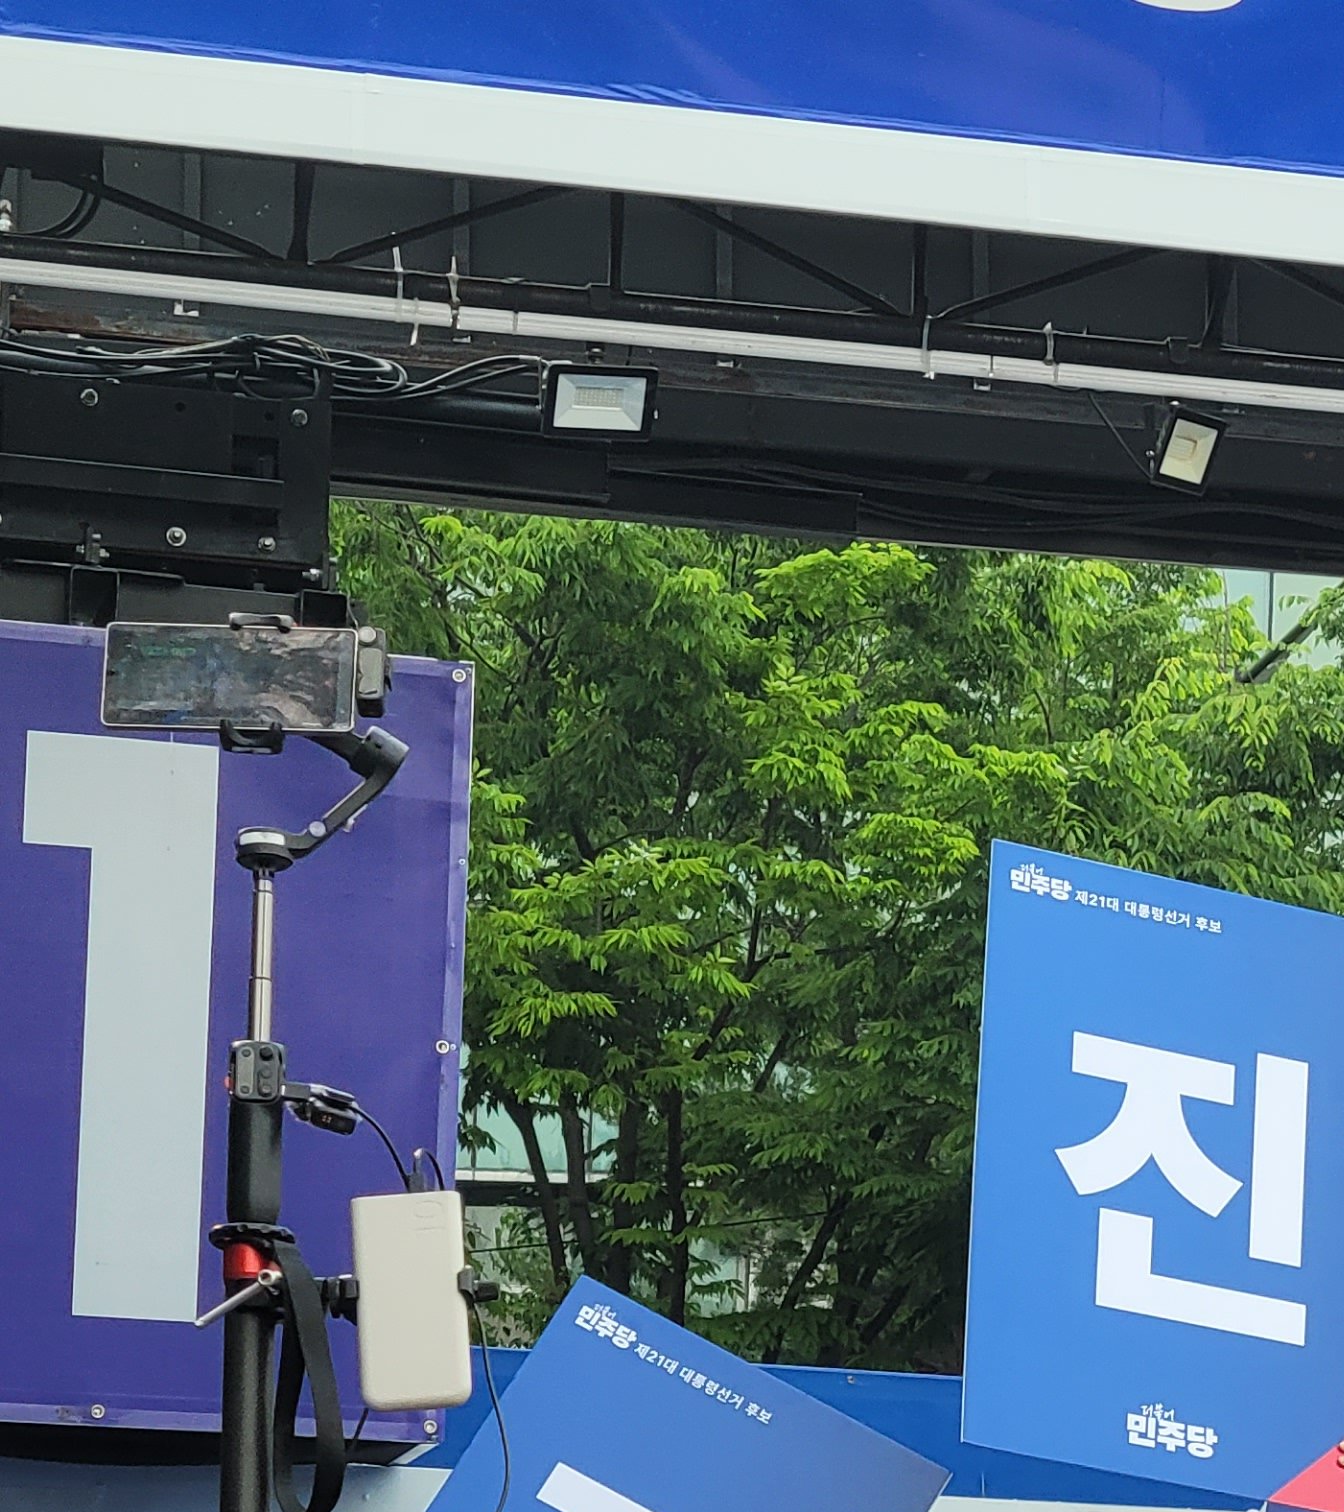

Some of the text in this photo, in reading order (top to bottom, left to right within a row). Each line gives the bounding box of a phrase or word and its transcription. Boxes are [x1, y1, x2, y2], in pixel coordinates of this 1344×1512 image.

[1010, 868, 1223, 934] 민주당 제21대 대통령선거 후보
[23, 730, 219, 1322] 1
[1054, 1031, 1310, 1347] 진
[575, 1305, 774, 1425] 민주당 제21대 대통령선거 후보
[1126, 1412, 1219, 1459] 민주당
